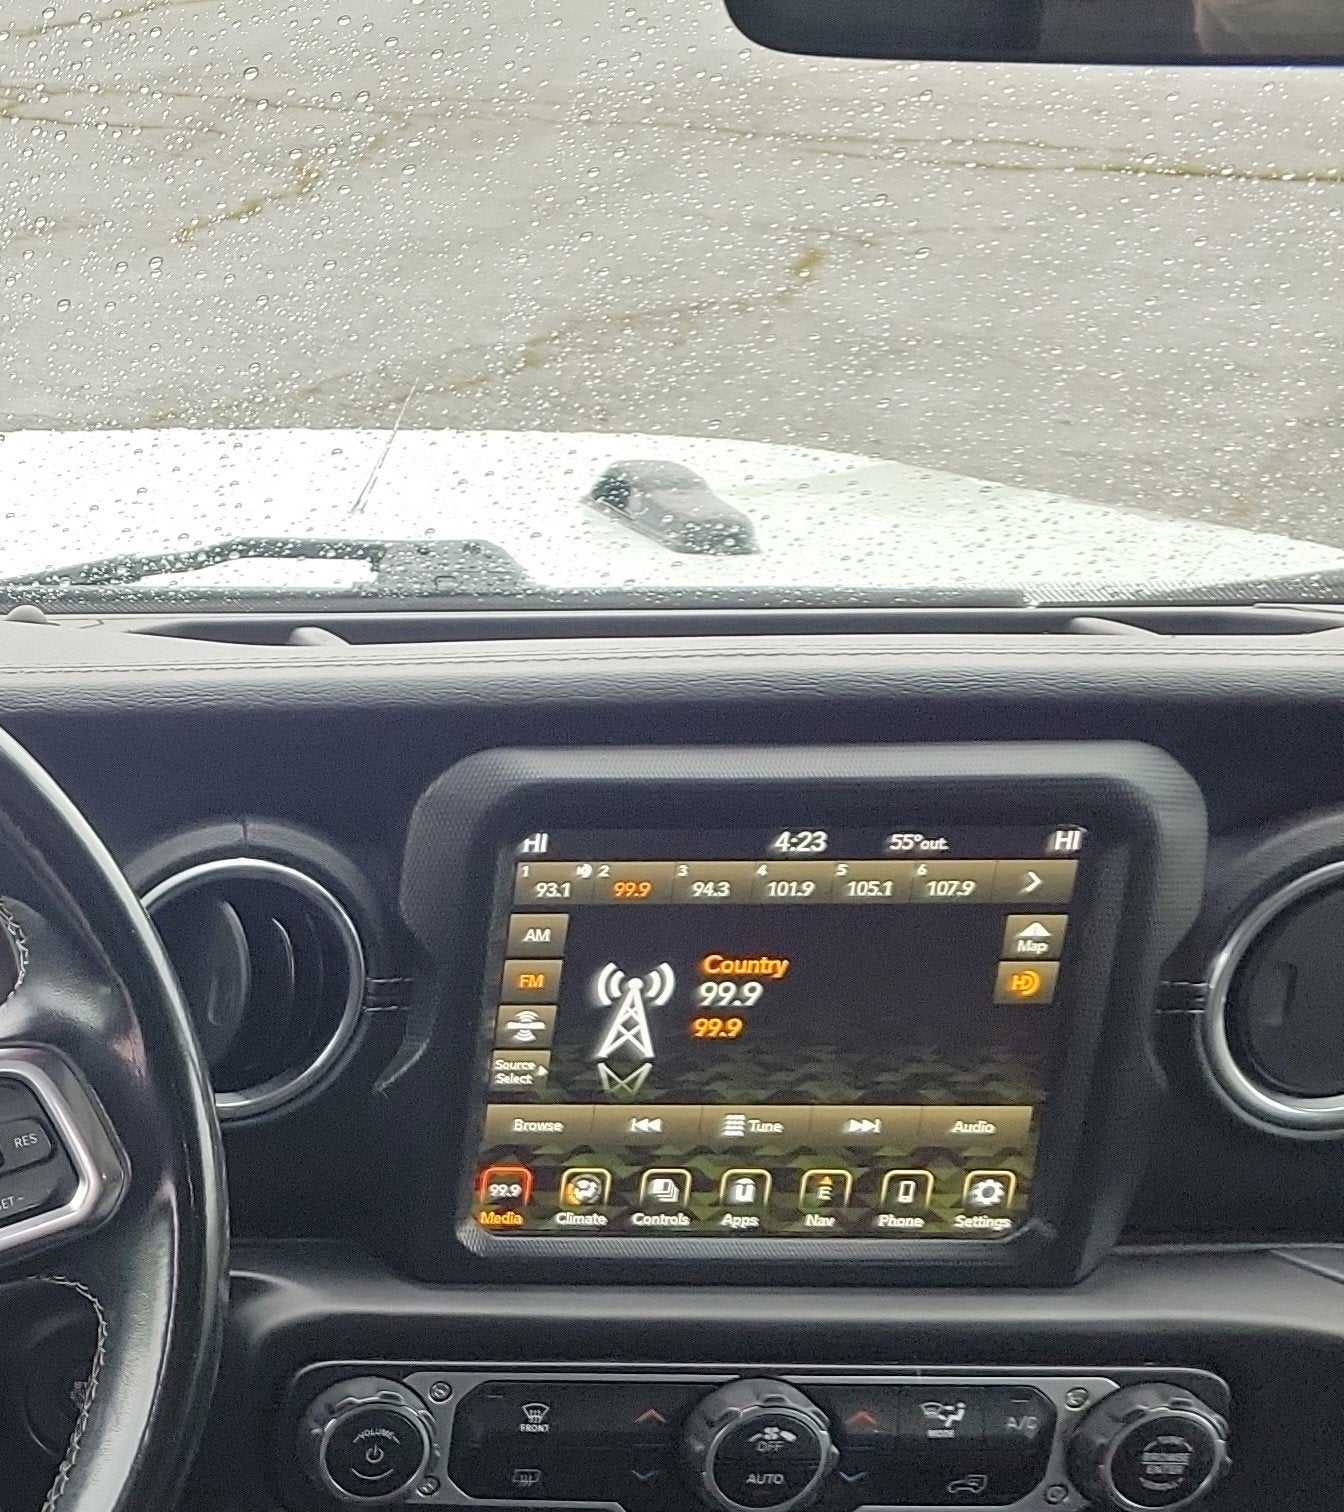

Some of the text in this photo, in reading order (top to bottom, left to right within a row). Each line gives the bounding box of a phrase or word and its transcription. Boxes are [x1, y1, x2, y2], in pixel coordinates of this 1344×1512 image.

[522, 833, 549, 853] HI
[773, 831, 828, 852] 4:23
[1052, 830, 1082, 851] HI
[521, 865, 530, 878] 1
[598, 864, 610, 878] 2
[677, 864, 689, 877] 3
[756, 864, 768, 877] 4
[835, 863, 848, 876] 5
[916, 863, 928, 876] 6
[535, 881, 571, 898] 93.1
[614, 881, 653, 898] 99.9
[692, 881, 731, 897] 94.3
[767, 880, 816, 897] 101.9
[845, 880, 893, 897] 105.1
[925, 880, 976, 897] 107.9
[523, 927, 551, 942] AM
[1017, 939, 1049, 955] Map
[703, 953, 790, 978] Country
[519, 974, 545, 989] FM
[698, 981, 764, 1007] 99.9
[692, 1017, 744, 1038] 99.9
[494, 1059, 537, 1071] Source
[496, 1073, 533, 1085] Select
[513, 1118, 564, 1132] Browse
[748, 1119, 784, 1134] Tune
[951, 1120, 996, 1134] Audio
[14, 1133, 38, 1148] RES
[488, 1183, 523, 1198] 99.9
[480, 1211, 523, 1226] Media
[555, 1211, 608, 1226] Climate
[632, 1212, 691, 1227] Controls
[720, 1213, 760, 1229] Apps
[805, 1214, 836, 1228] Nav
[877, 1214, 925, 1228] Phone
[954, 1214, 1012, 1231] Settings
[520, 1424, 550, 1433] FRONT
[745, 1473, 785, 1485] AUTO
